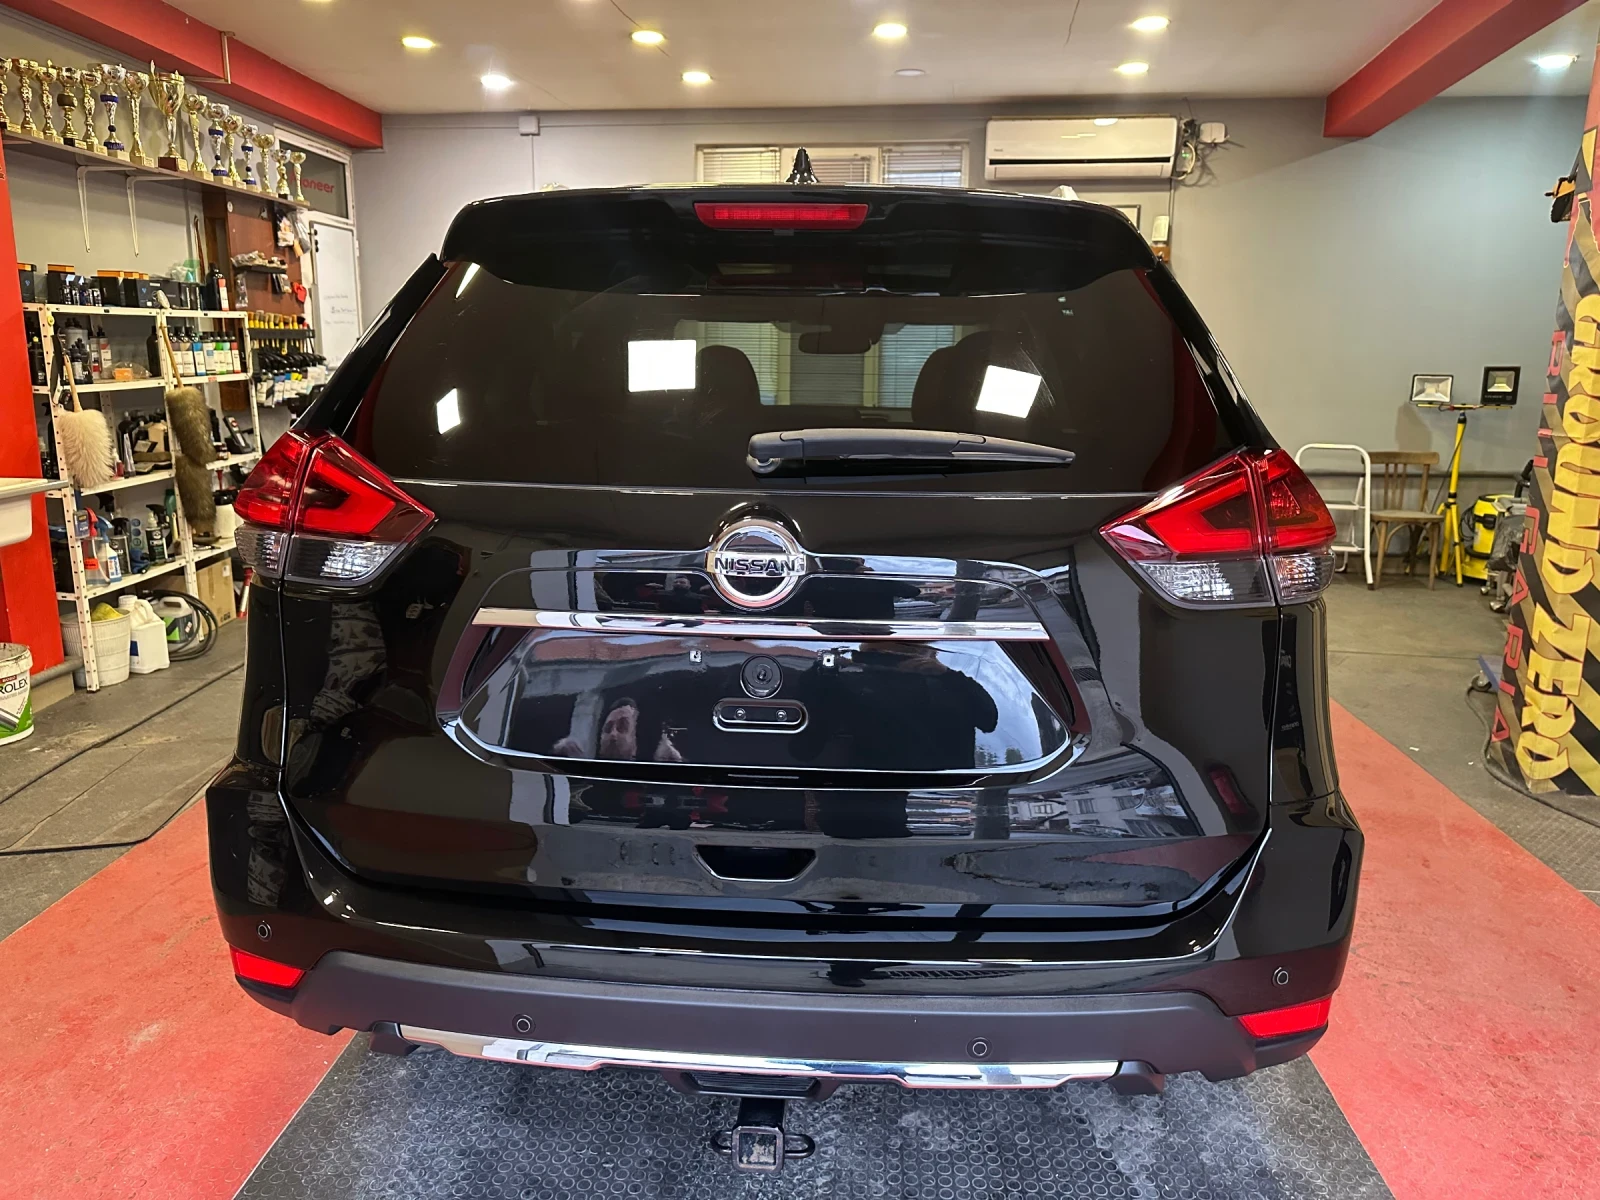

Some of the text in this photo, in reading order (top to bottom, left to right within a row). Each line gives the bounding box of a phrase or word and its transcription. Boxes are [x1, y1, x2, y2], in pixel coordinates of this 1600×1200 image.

[289, 169, 335, 193] oneer
[714, 557, 796, 572] NISSAN
[1515, 601, 1591, 780] ZERO
